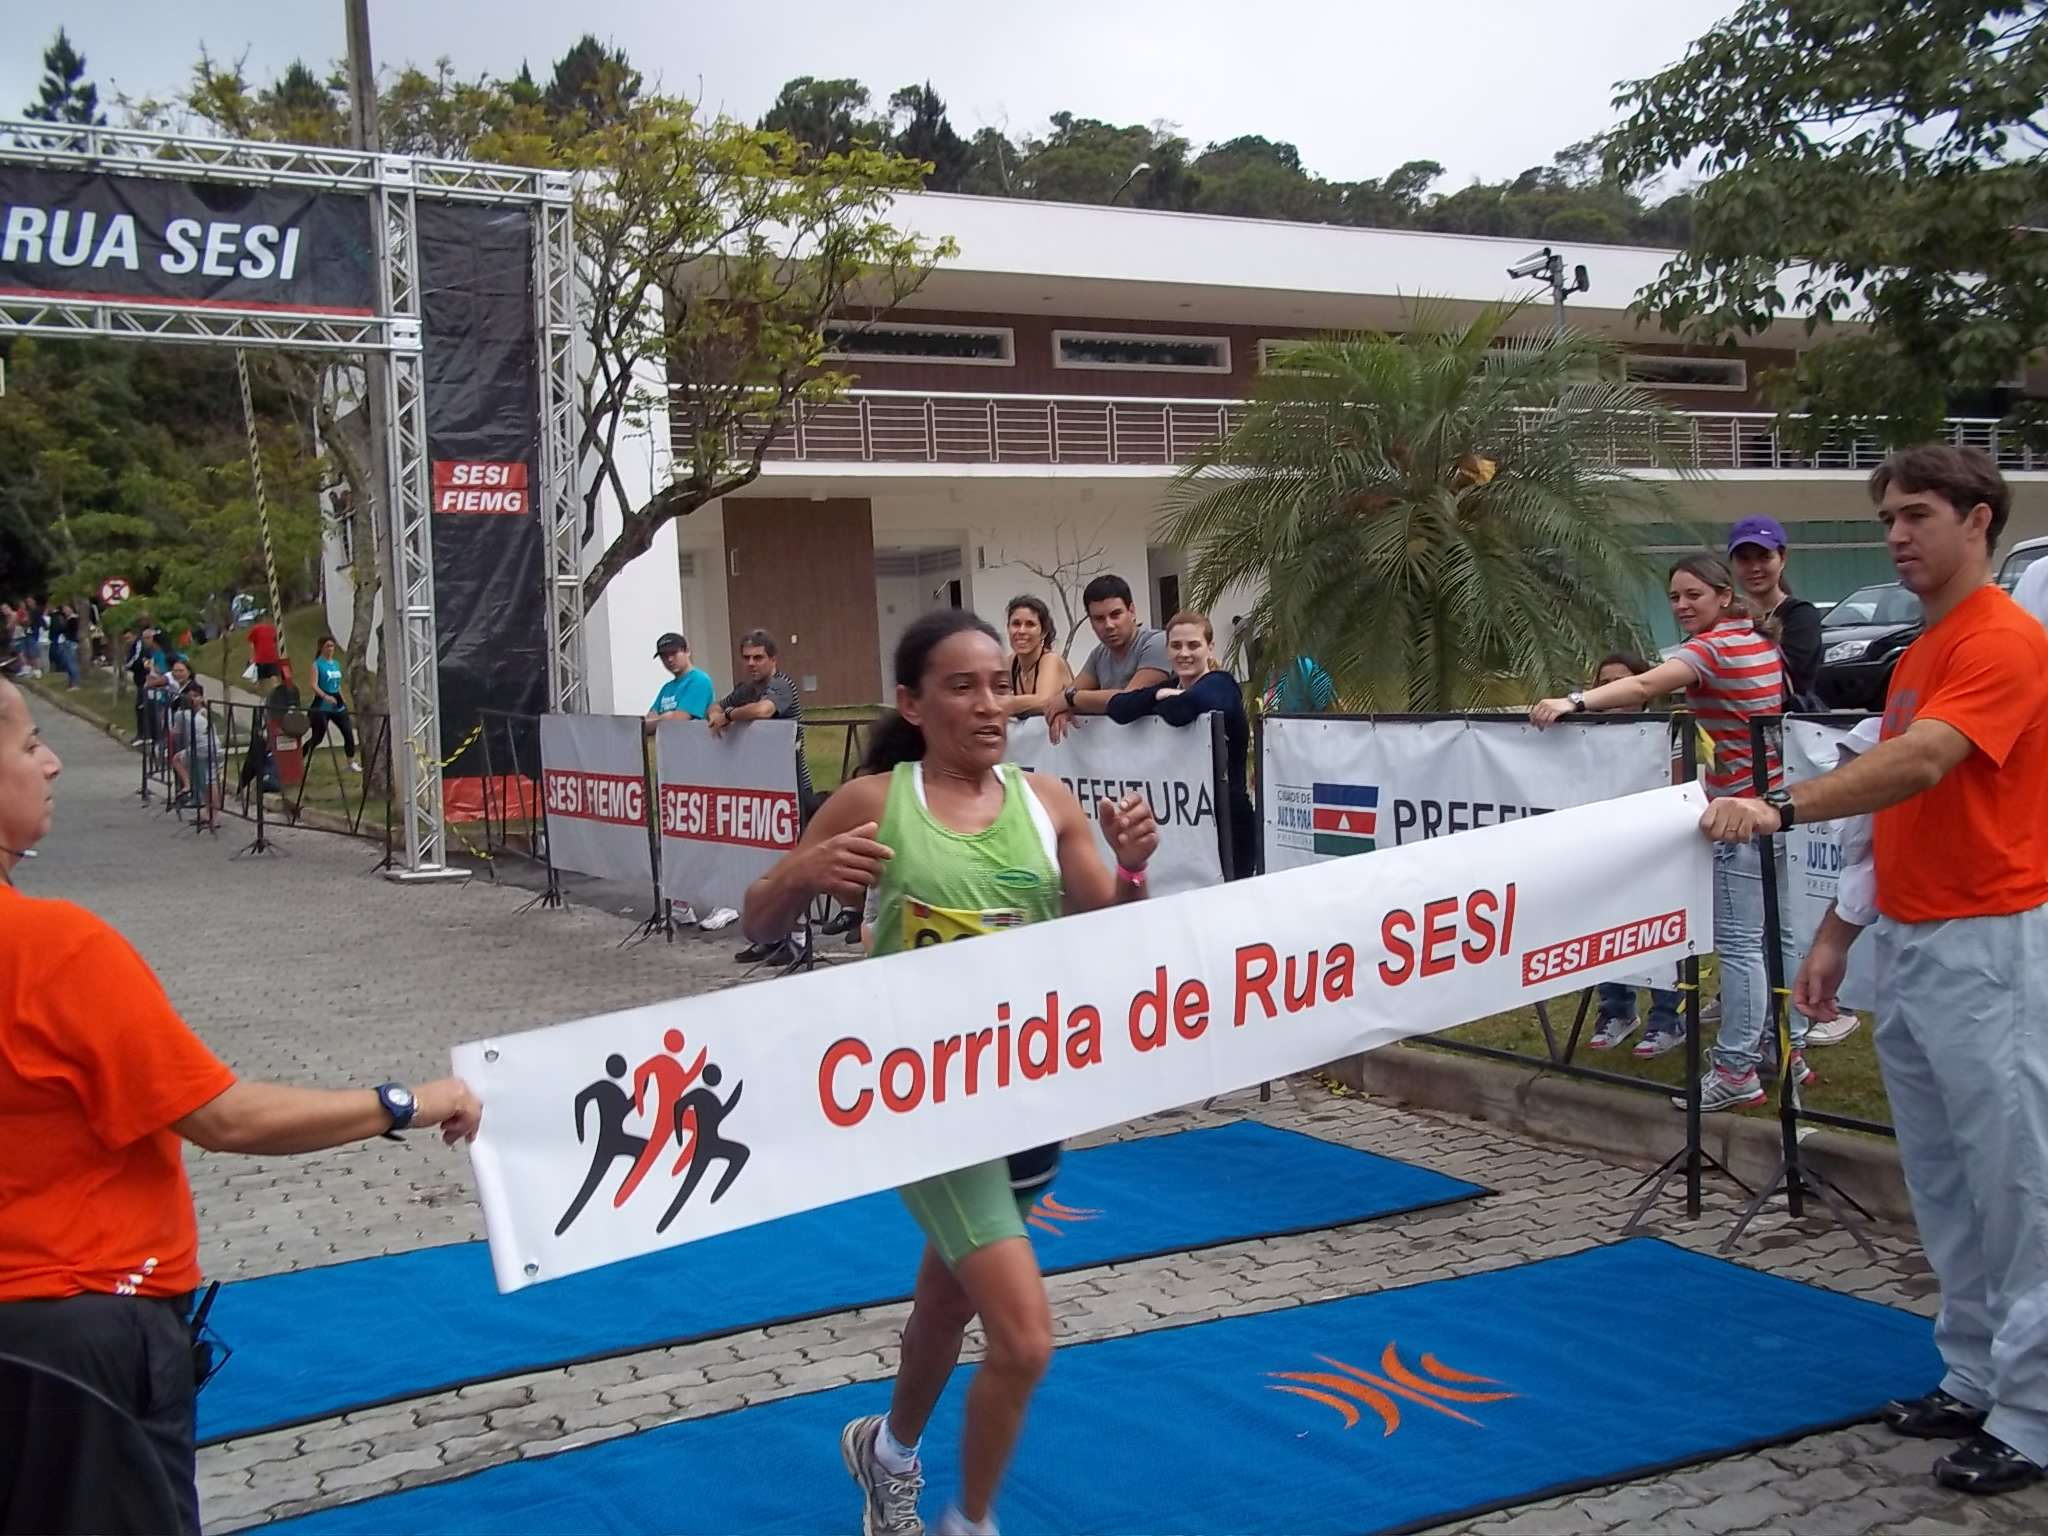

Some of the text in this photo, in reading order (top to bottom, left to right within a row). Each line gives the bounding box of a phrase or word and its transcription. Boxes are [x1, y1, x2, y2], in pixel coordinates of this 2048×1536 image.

[1, 206, 300, 280] RUA SESI
[452, 464, 509, 485] SESI
[442, 491, 521, 512] FIEMG
[549, 775, 642, 821] SESI FIEMG
[666, 790, 794, 844] SESI FIEMG
[1807, 841, 1827, 870] JUIZ
[1527, 915, 1682, 981] SESI FIEMG
[818, 883, 1516, 1127] Corrida de Rua SESI
